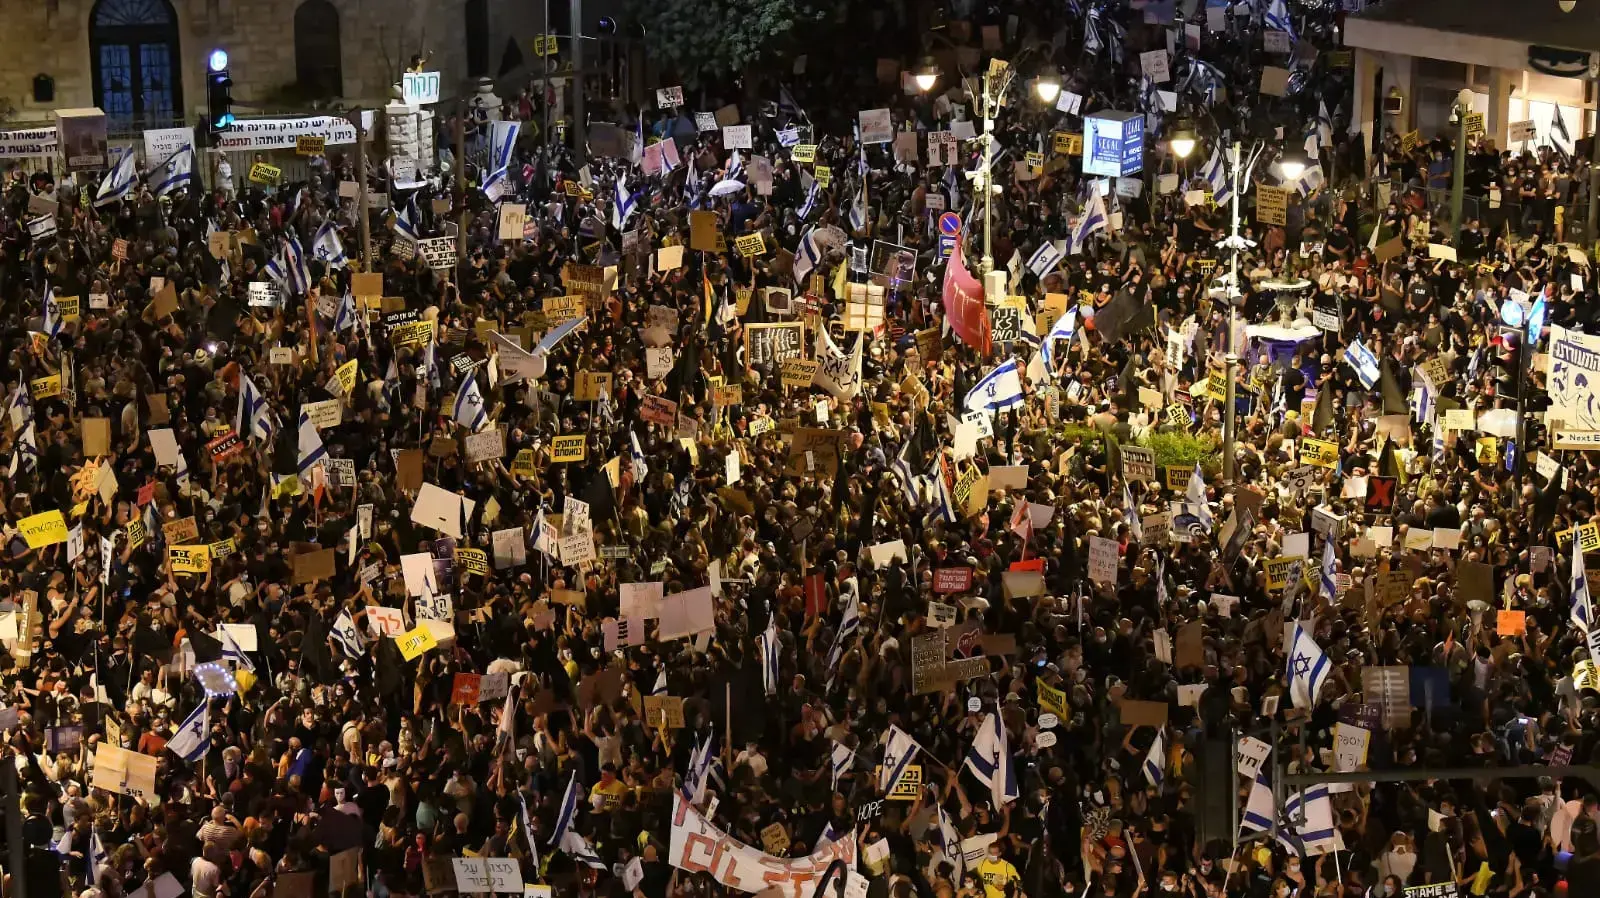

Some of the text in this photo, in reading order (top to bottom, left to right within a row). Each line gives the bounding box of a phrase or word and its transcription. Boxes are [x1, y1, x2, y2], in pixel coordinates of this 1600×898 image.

[1569, 433, 1590, 442] Next
[212, 438, 238, 455] LIVES
[857, 799, 884, 821] HOPE
[1405, 886, 1441, 898] SHAME
